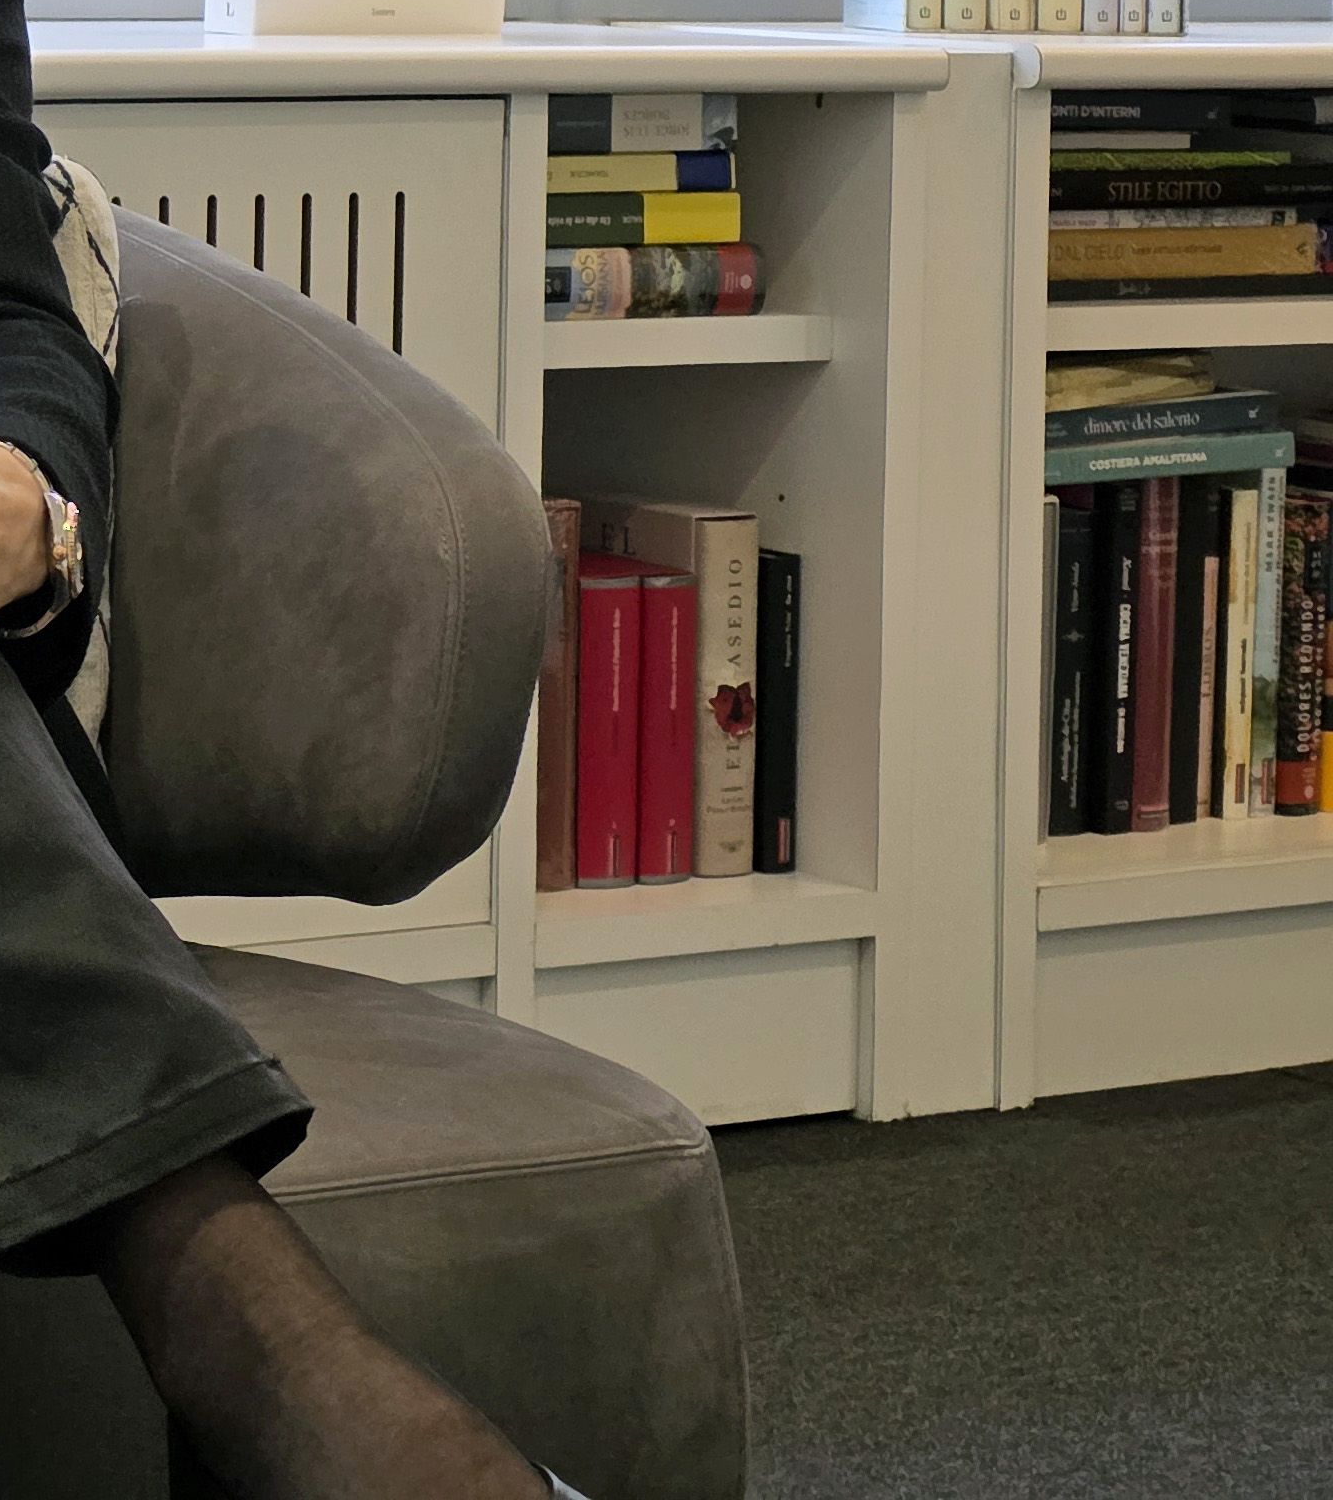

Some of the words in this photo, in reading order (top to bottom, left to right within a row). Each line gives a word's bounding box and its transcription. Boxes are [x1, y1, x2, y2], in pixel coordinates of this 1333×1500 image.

[1051, 104, 1079, 117] ONTI
[1109, 180, 1152, 202] STILE
[1156, 180, 1223, 202] EGITTO
[1083, 416, 1130, 435] dimore
[1132, 412, 1152, 432] del
[1153, 410, 1201, 429] salento
[1089, 455, 1141, 471] COSTIERA
[1142, 451, 1208, 467] AMALFITANA
[726, 558, 744, 669] ASEDIO
[1299, 600, 1314, 674] REDONDO
[1296, 680, 1312, 754] DOLORES
